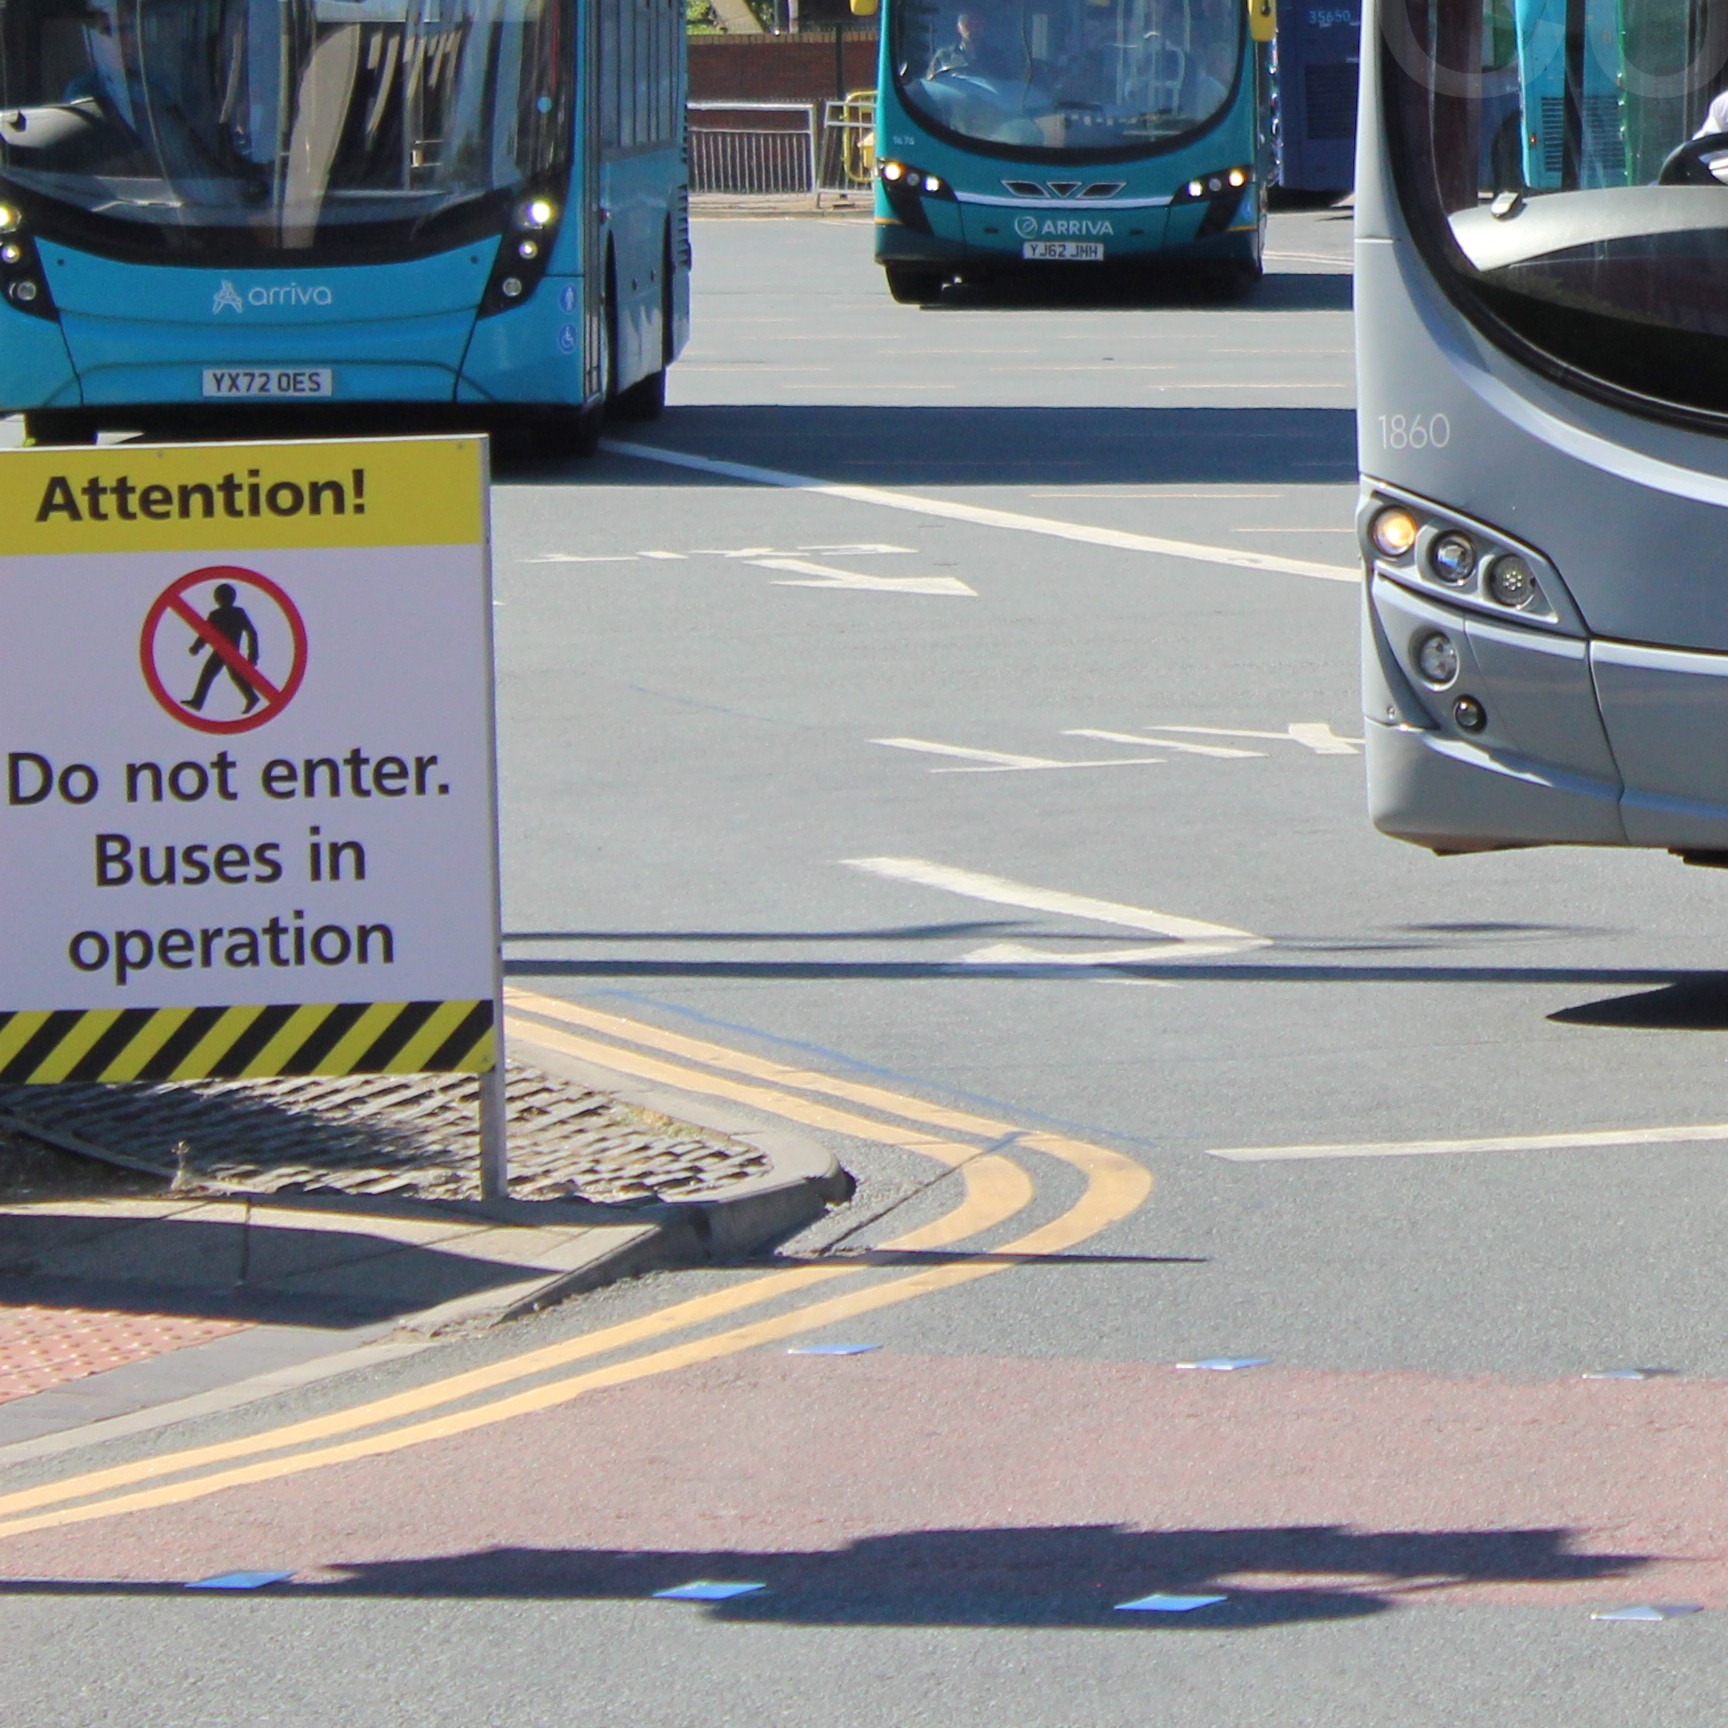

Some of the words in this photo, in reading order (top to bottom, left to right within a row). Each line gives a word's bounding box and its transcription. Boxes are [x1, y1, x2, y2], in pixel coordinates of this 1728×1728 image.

[1041, 219, 1114, 236] ARRIVA
[1030, 243, 1066, 258] YJ62
[247, 281, 333, 306] arriva
[212, 372, 271, 393] YX72
[277, 372, 322, 393] OES
[1376, 413, 1451, 450] 1860
[35, 467, 367, 523] Attention!
[7, 751, 99, 806] Do
[125, 750, 238, 803] not
[260, 746, 451, 800] enter.
[94, 832, 283, 887] Buses
[308, 825, 367, 882] in
[67, 908, 395, 986] operation
